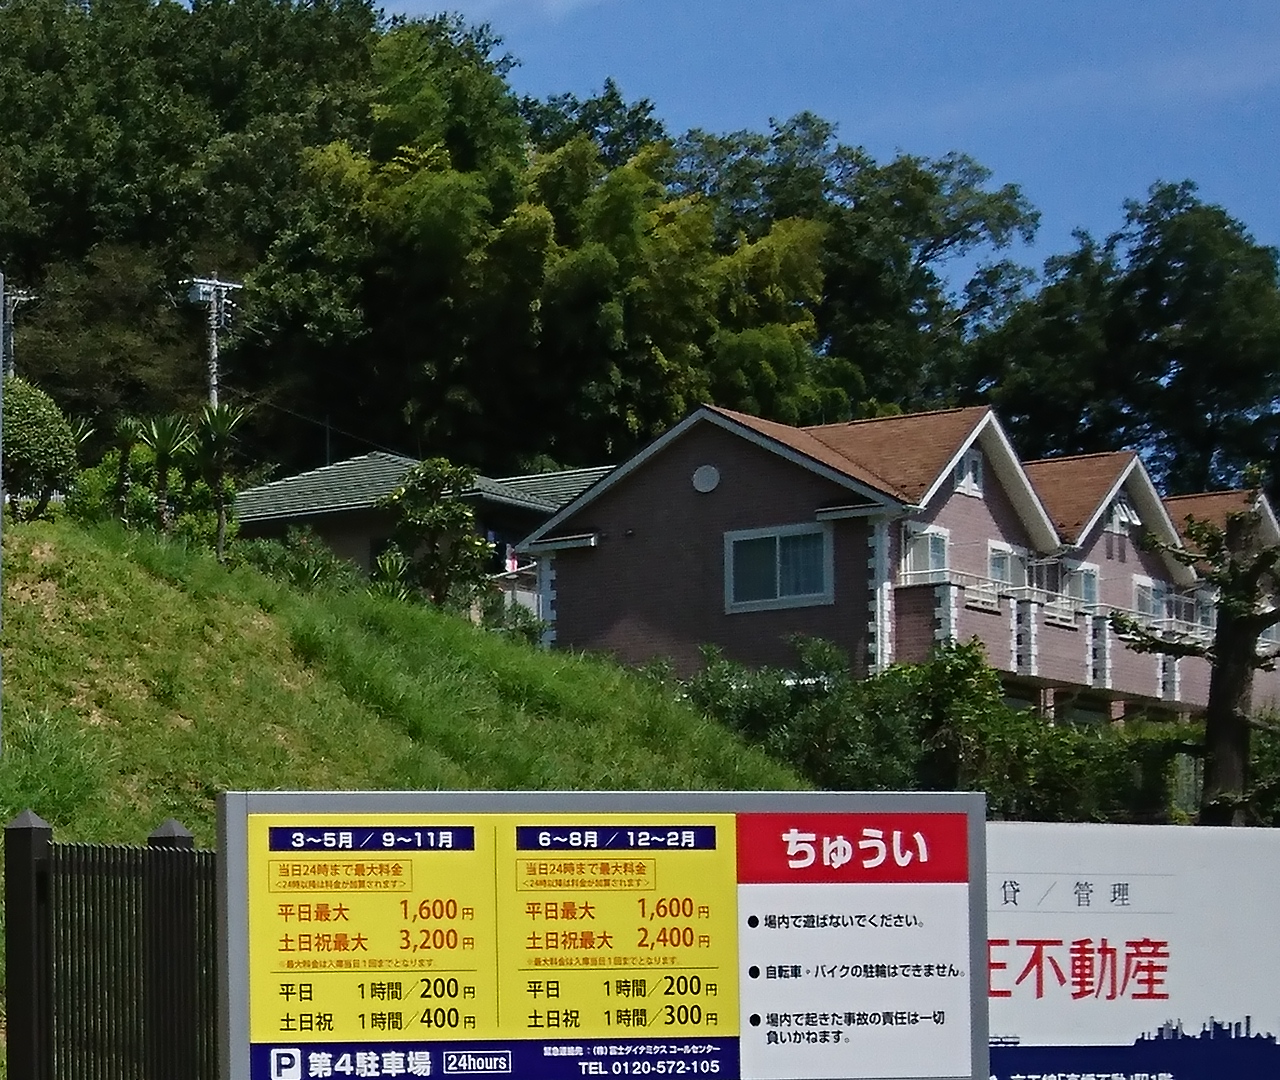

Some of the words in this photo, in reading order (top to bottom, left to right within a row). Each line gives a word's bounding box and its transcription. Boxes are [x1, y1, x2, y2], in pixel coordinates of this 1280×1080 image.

[781, 828, 928, 869] ちゅうい
[278, 863, 403, 877] 当日24時まで最大料金
[526, 862, 647, 876] 当日24時まで最大料金
[1074, 881, 1130, 906] 管理
[278, 903, 350, 922] 平日最大
[525, 902, 595, 920] 平日最大
[764, 914, 923, 929] 場内で遊ばないでください。
[278, 933, 368, 952] 土日祝最大
[526, 931, 613, 950] 土日祝最大
[766, 964, 965, 979] 自転車・バイクの駐輪はできません。
[279, 983, 313, 1002] 平日
[526, 980, 560, 999] 平日
[280, 1013, 333, 1032] 土日祝
[528, 1009, 580, 1028] 土日祝
[766, 1011, 945, 1027] 場内で起きた事故の責任は一切
[766, 1030, 850, 1045] 負いかねます。
[309, 1052, 431, 1078] 第4駐車場
[447, 1054, 507, 1071] 24hours
[578, 1061, 608, 1075] TEL
[612, 1060, 720, 1074] 0120-572-105
